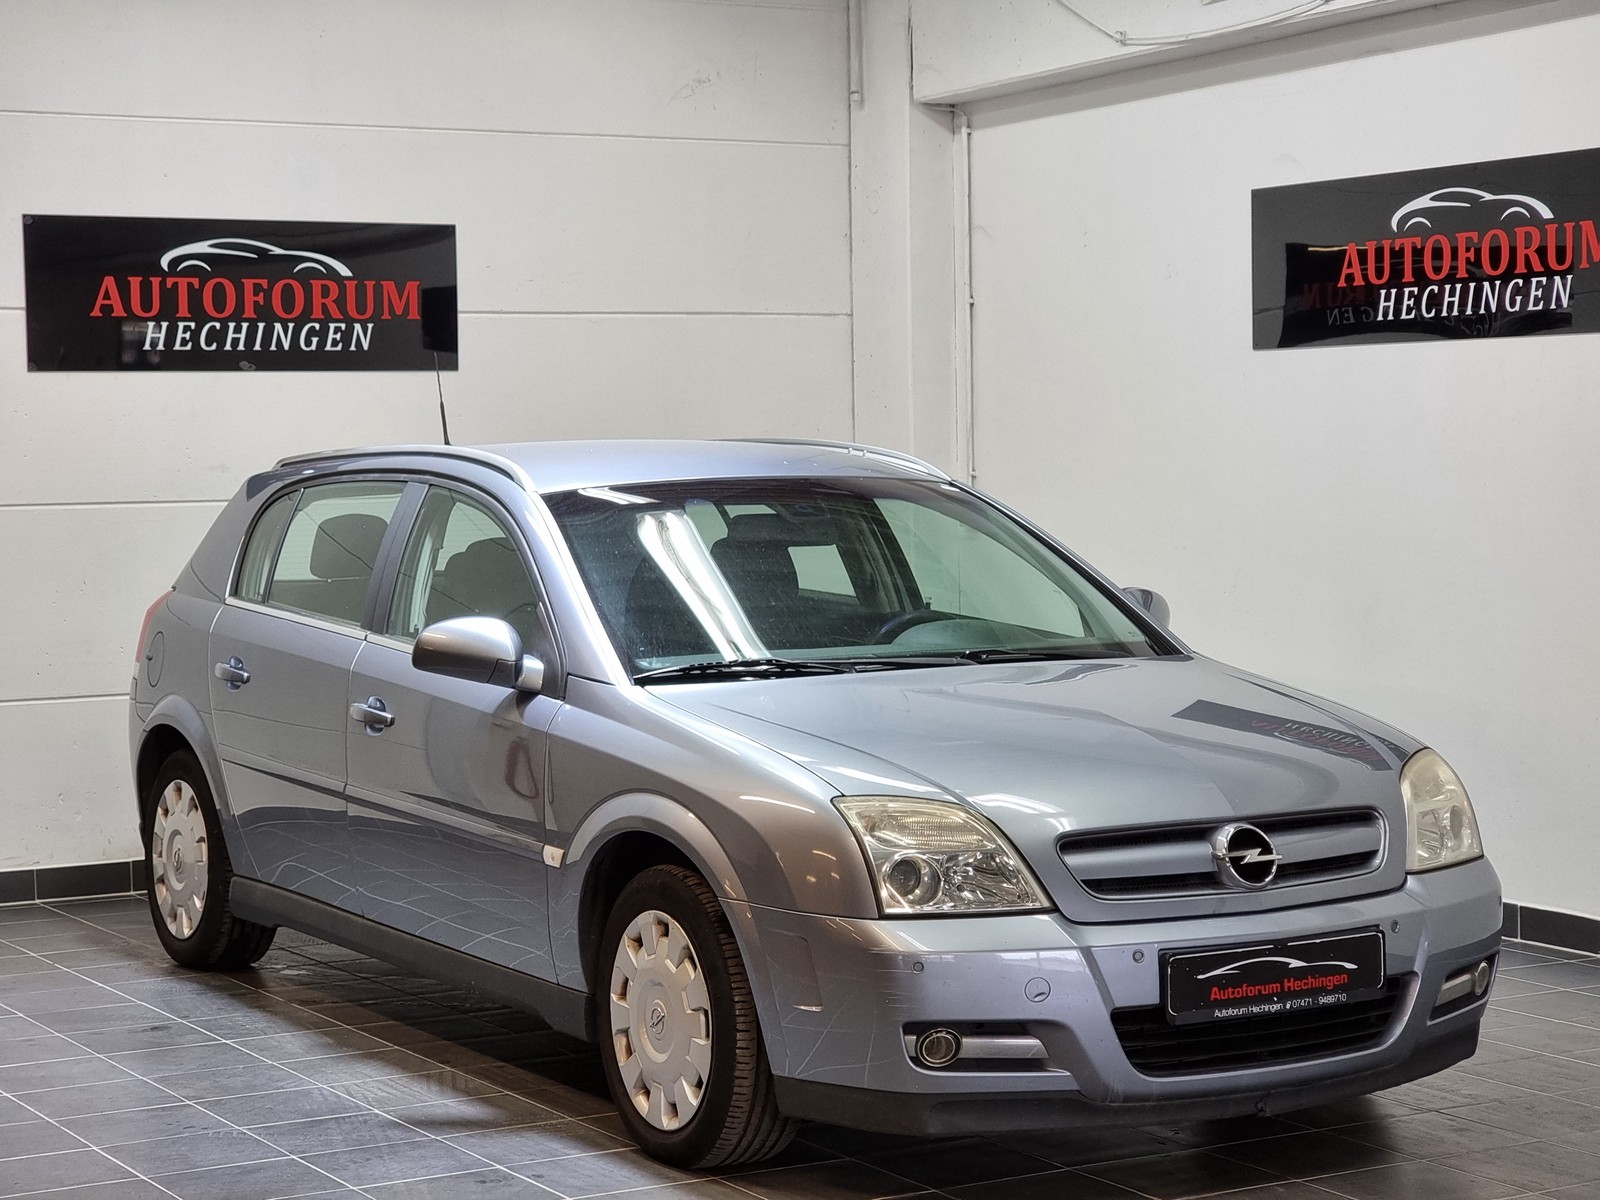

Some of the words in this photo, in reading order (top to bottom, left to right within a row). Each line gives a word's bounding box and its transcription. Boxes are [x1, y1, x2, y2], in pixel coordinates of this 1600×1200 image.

[1337, 220, 1600, 288] AUTOFORUM
[90, 275, 421, 320] AUTOFORUM
[1376, 274, 1574, 321] HECHINGEN
[142, 321, 374, 352] HECHINGEN
[1210, 982, 1281, 1001] Autoforum
[1283, 973, 1348, 992] Hechingen
[1214, 1006, 1248, 1018] Autoforum
[1249, 1002, 1283, 1014] Hechingen
[1292, 998, 1313, 1008] 07471
[1318, 993, 1347, 1005] 9489710
